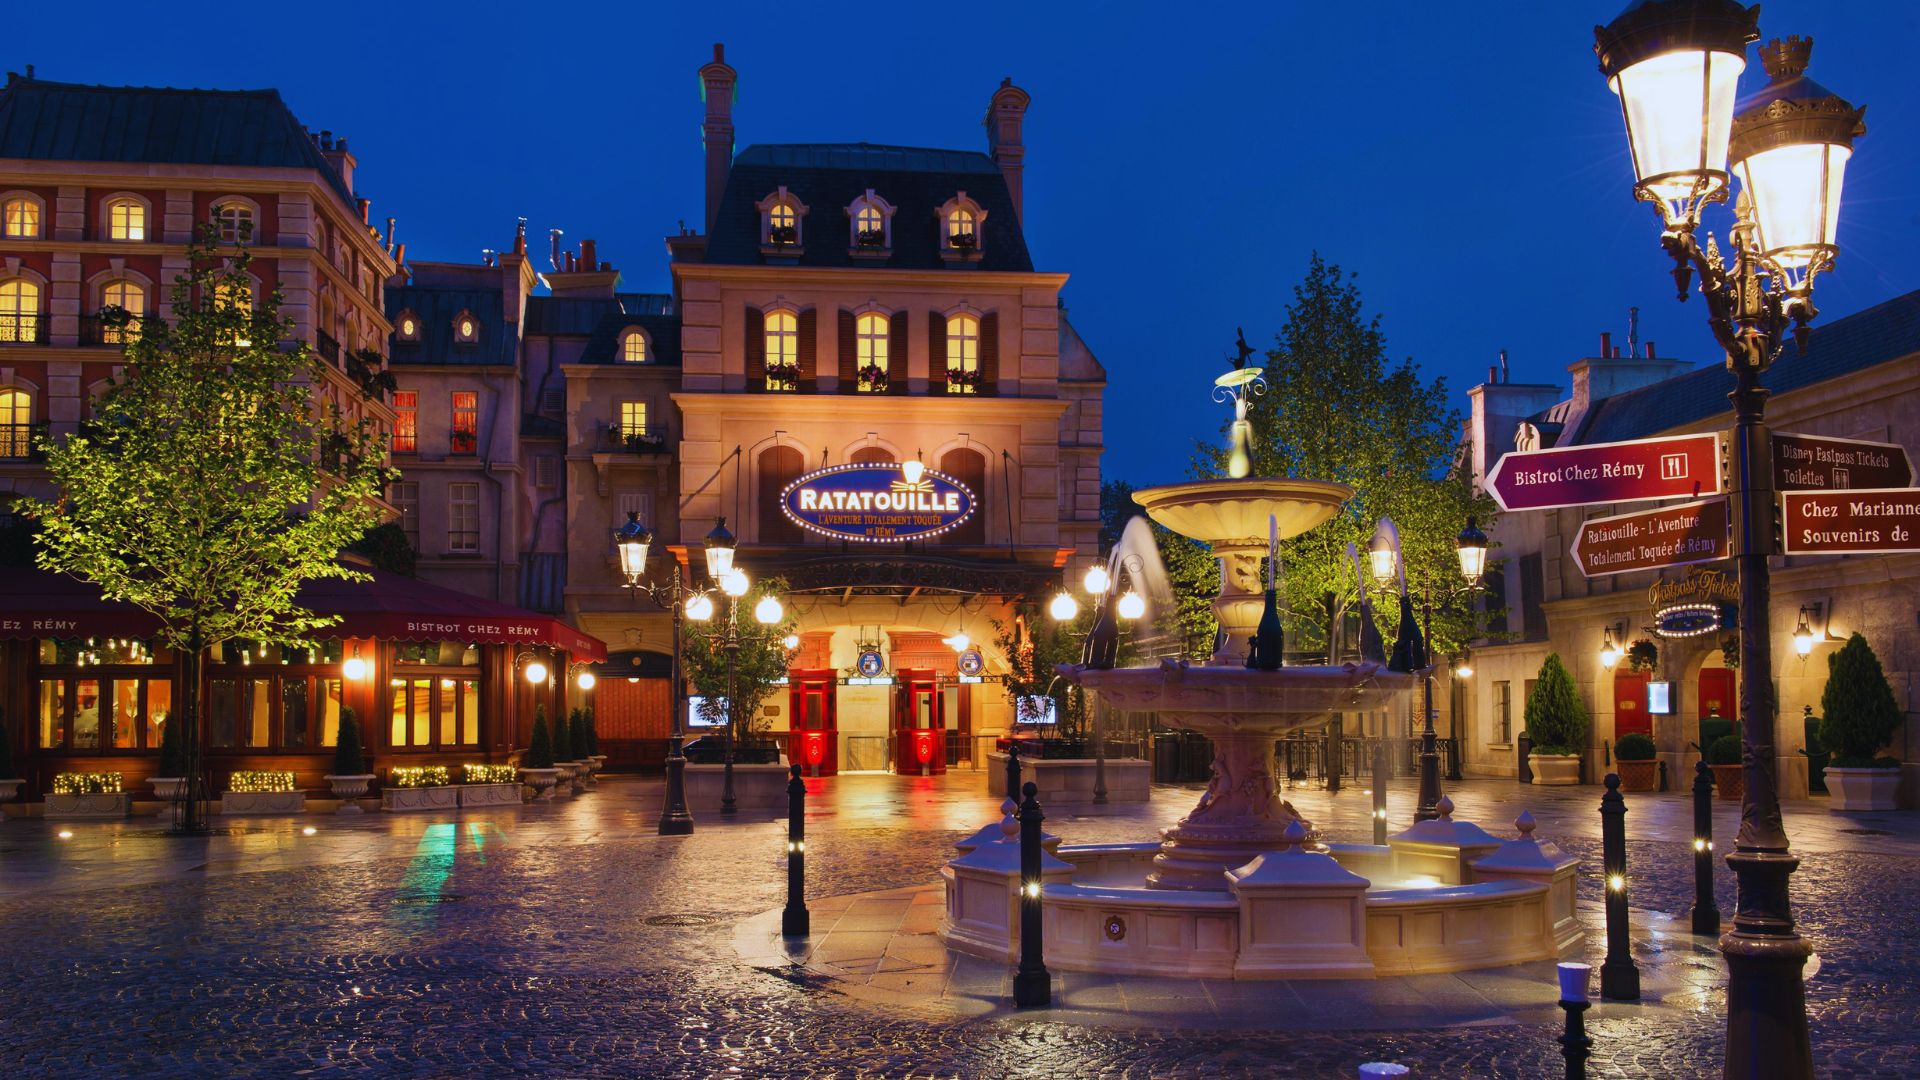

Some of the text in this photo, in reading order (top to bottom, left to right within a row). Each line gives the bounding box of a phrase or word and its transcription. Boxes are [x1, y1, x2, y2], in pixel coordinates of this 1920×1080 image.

[1782, 444, 1889, 468] Disney Fastpass Tickets
[1514, 461, 1645, 486] Bistrot Chez Rémy
[1783, 468, 1825, 486] Toilettes
[800, 488, 960, 512] RATATOUILLE
[1802, 500, 1920, 518] Chez Marianne
[818, 512, 942, 525] L'AVENTURE TOTALEMENT TOQUÉE
[875, 526, 897, 537] RÉMY
[1588, 522, 1639, 544] Ratatouille
[1648, 514, 1700, 535] L'Aventure
[1802, 524, 1909, 544] Souvenirs de
[1588, 535, 1717, 567] Totalement Toquée de Rémy
[33, 618, 77, 630] RÉMY
[407, 622, 540, 637] BISTROT CHEZ RÉMY
